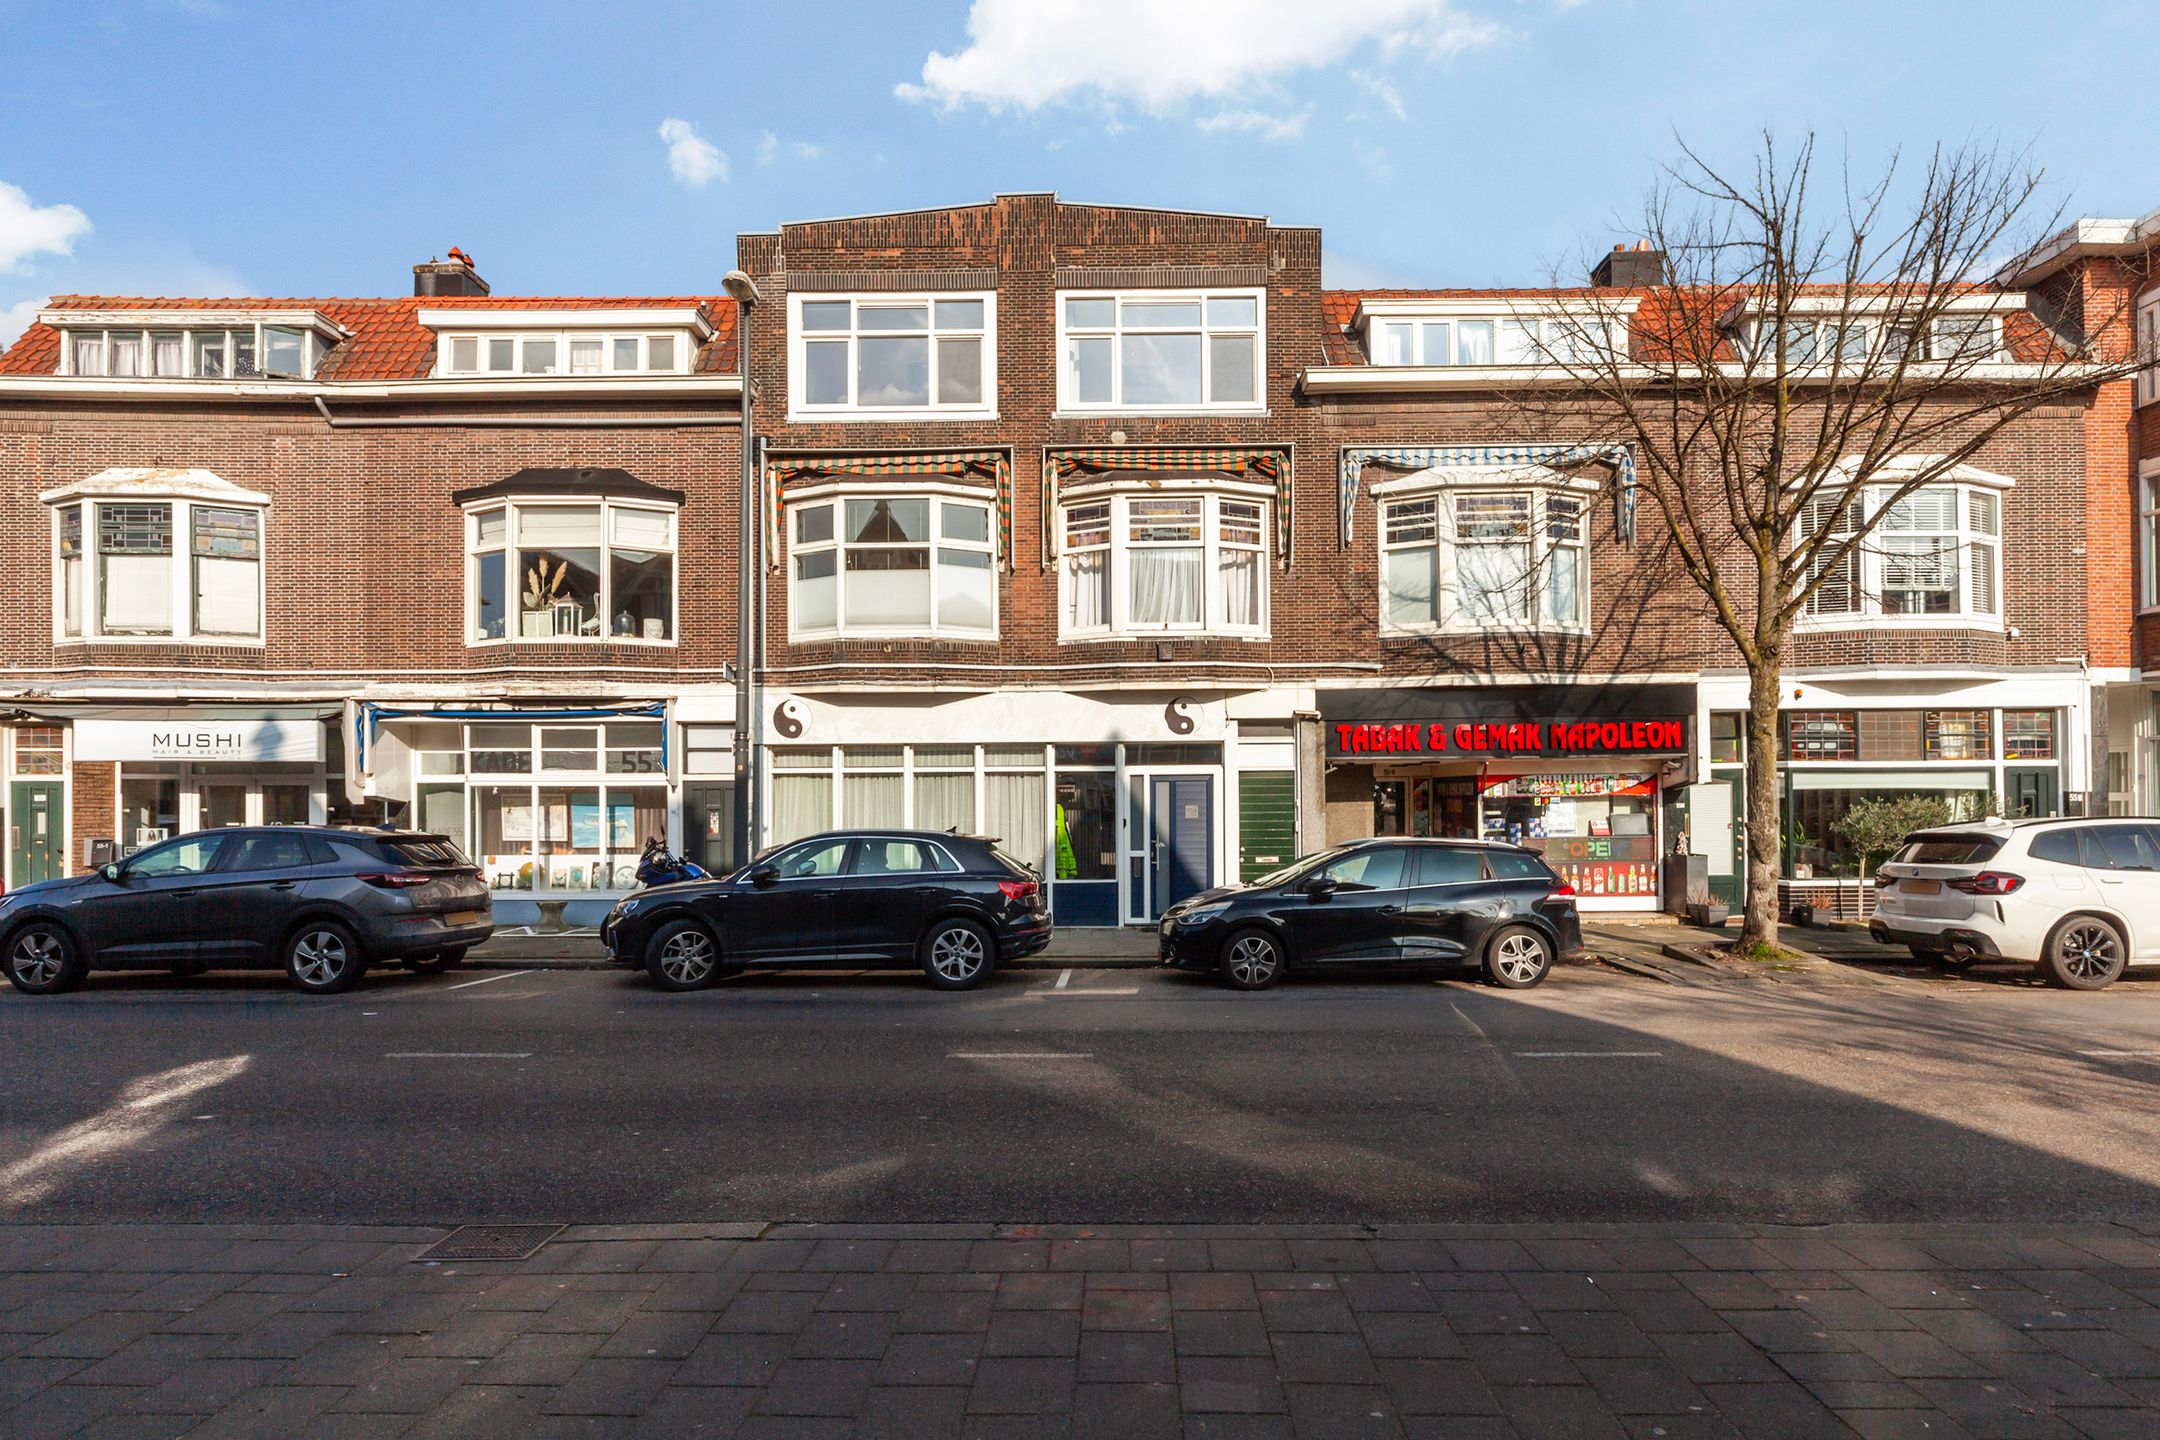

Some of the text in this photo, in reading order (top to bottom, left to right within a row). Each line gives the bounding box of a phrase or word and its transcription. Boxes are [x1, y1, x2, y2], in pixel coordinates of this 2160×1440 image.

[153, 733, 241, 748] MUSHI
[1336, 721, 1683, 754] TABAK & GEMAK NAPOLEON
[622, 750, 652, 773] 55
